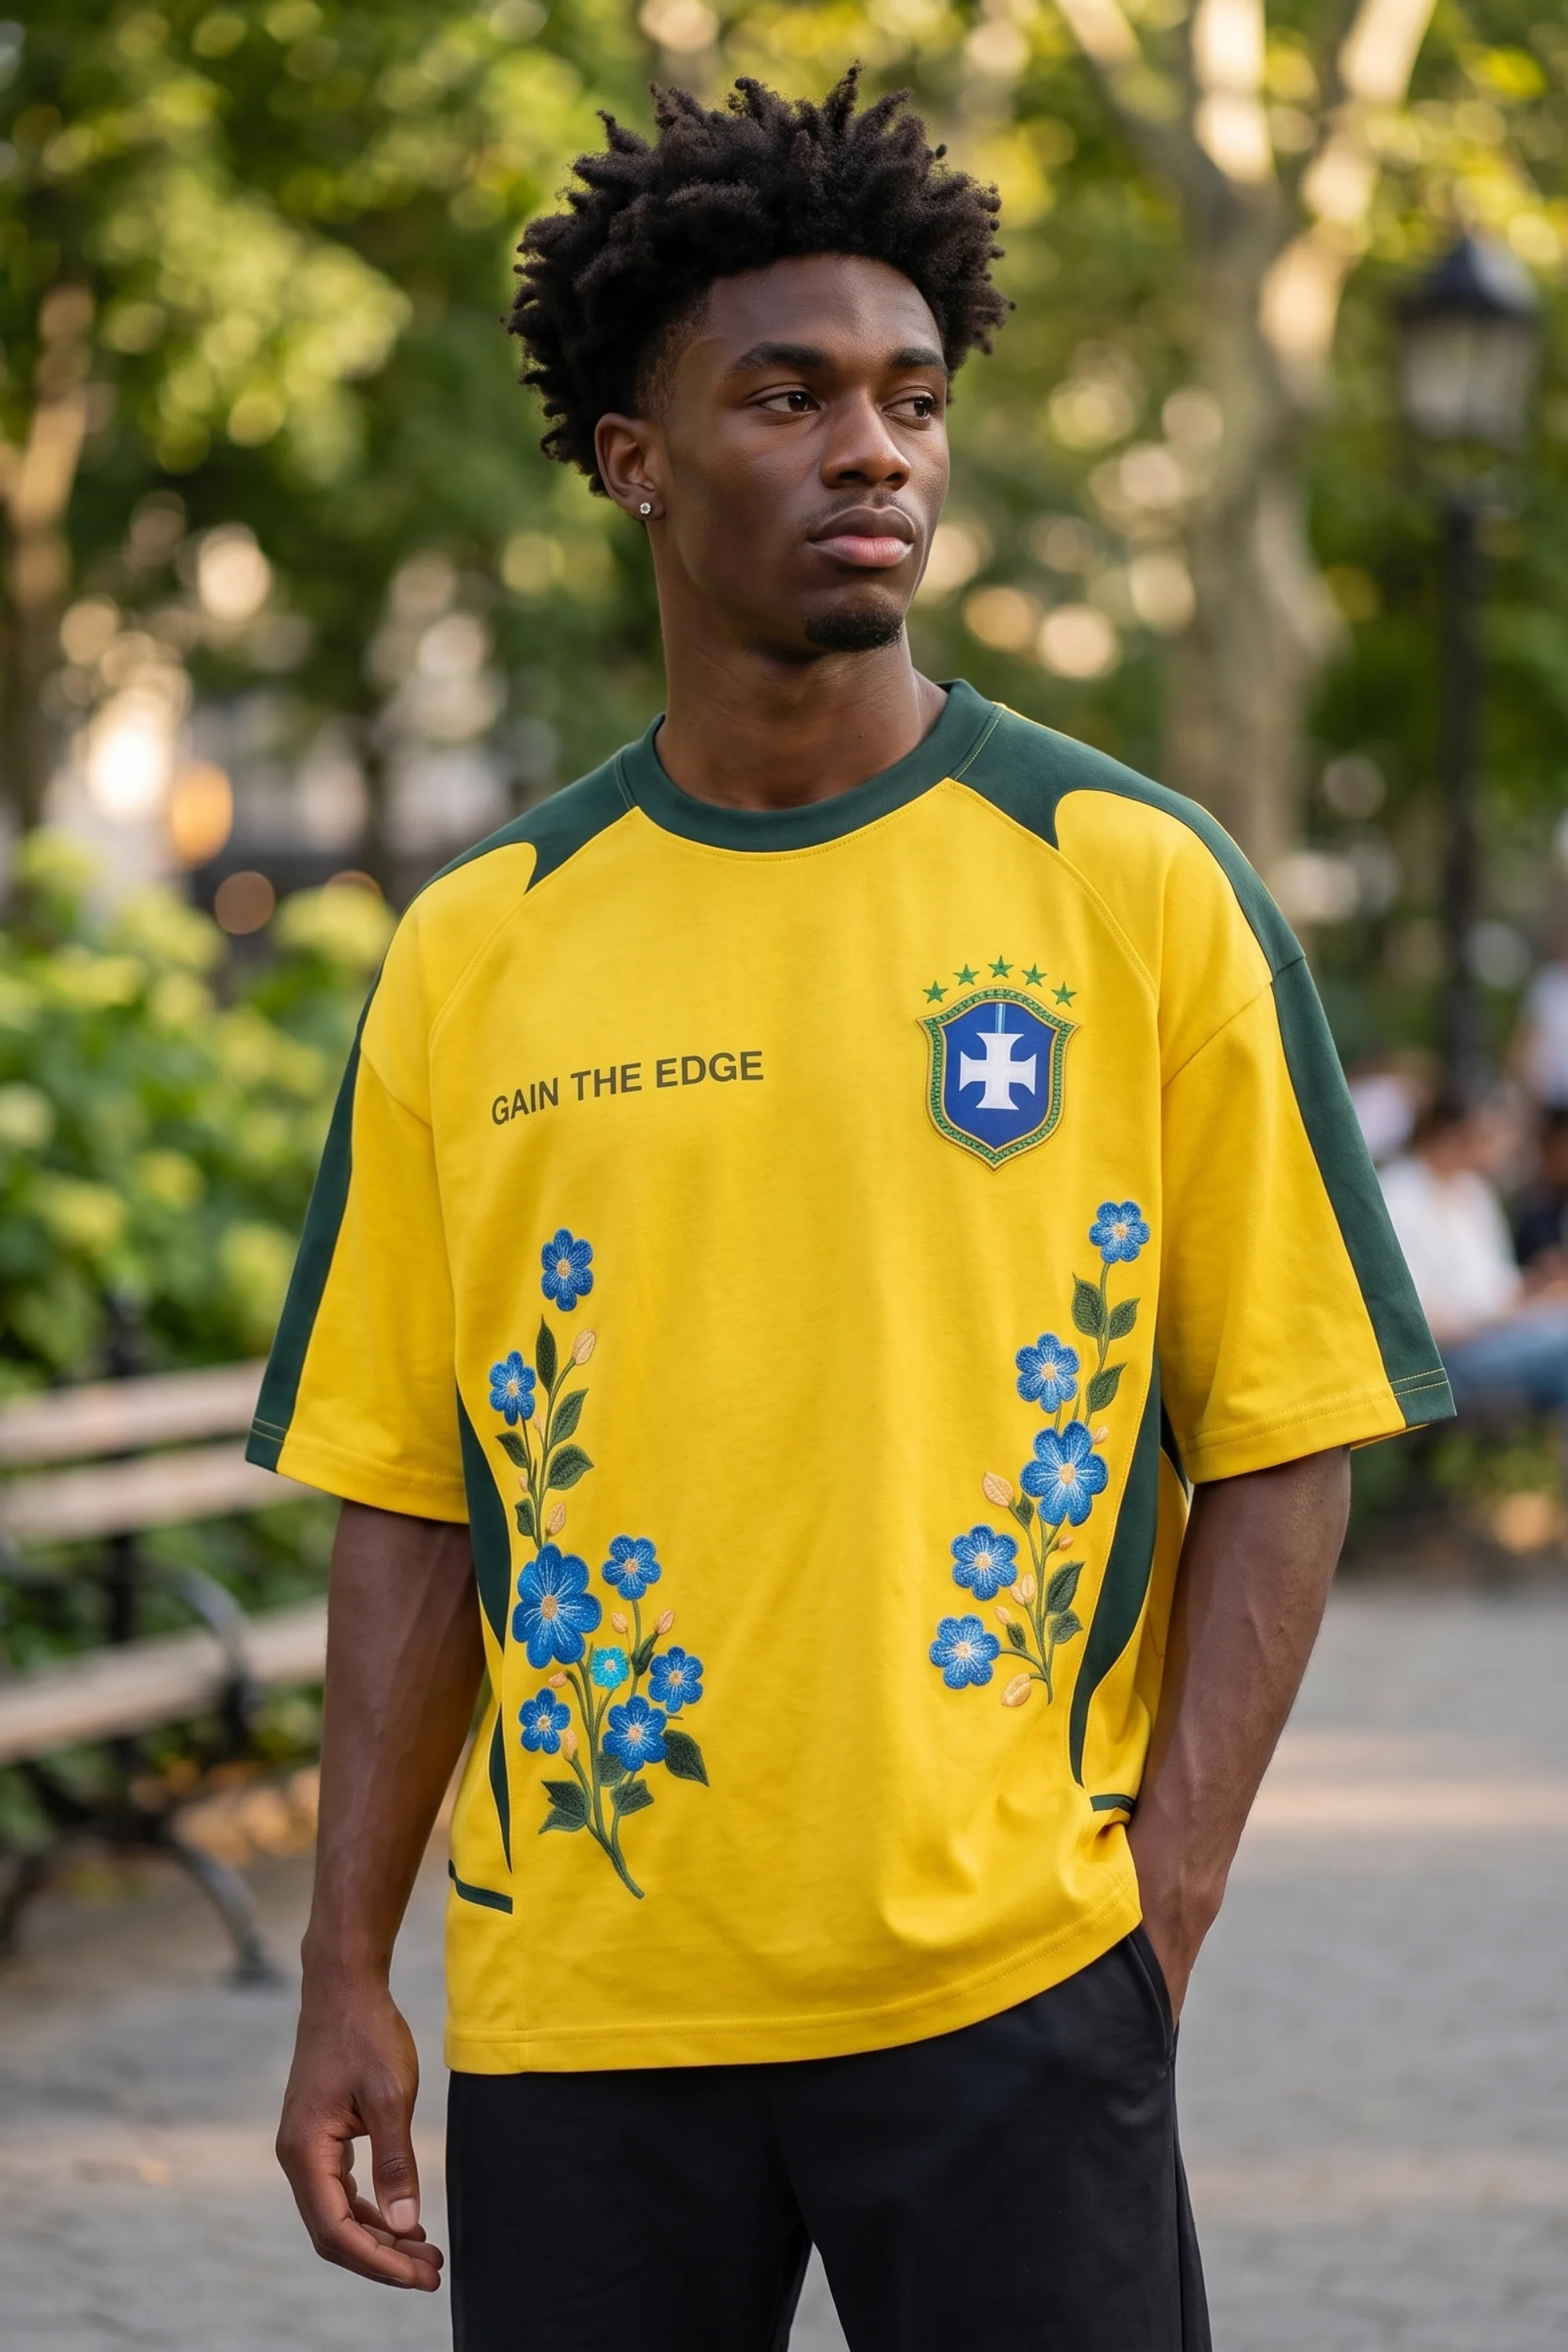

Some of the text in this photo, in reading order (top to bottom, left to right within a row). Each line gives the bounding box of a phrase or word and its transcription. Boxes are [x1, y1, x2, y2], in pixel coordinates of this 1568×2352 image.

[492, 1051, 764, 1126] GAIN THE EDGE
